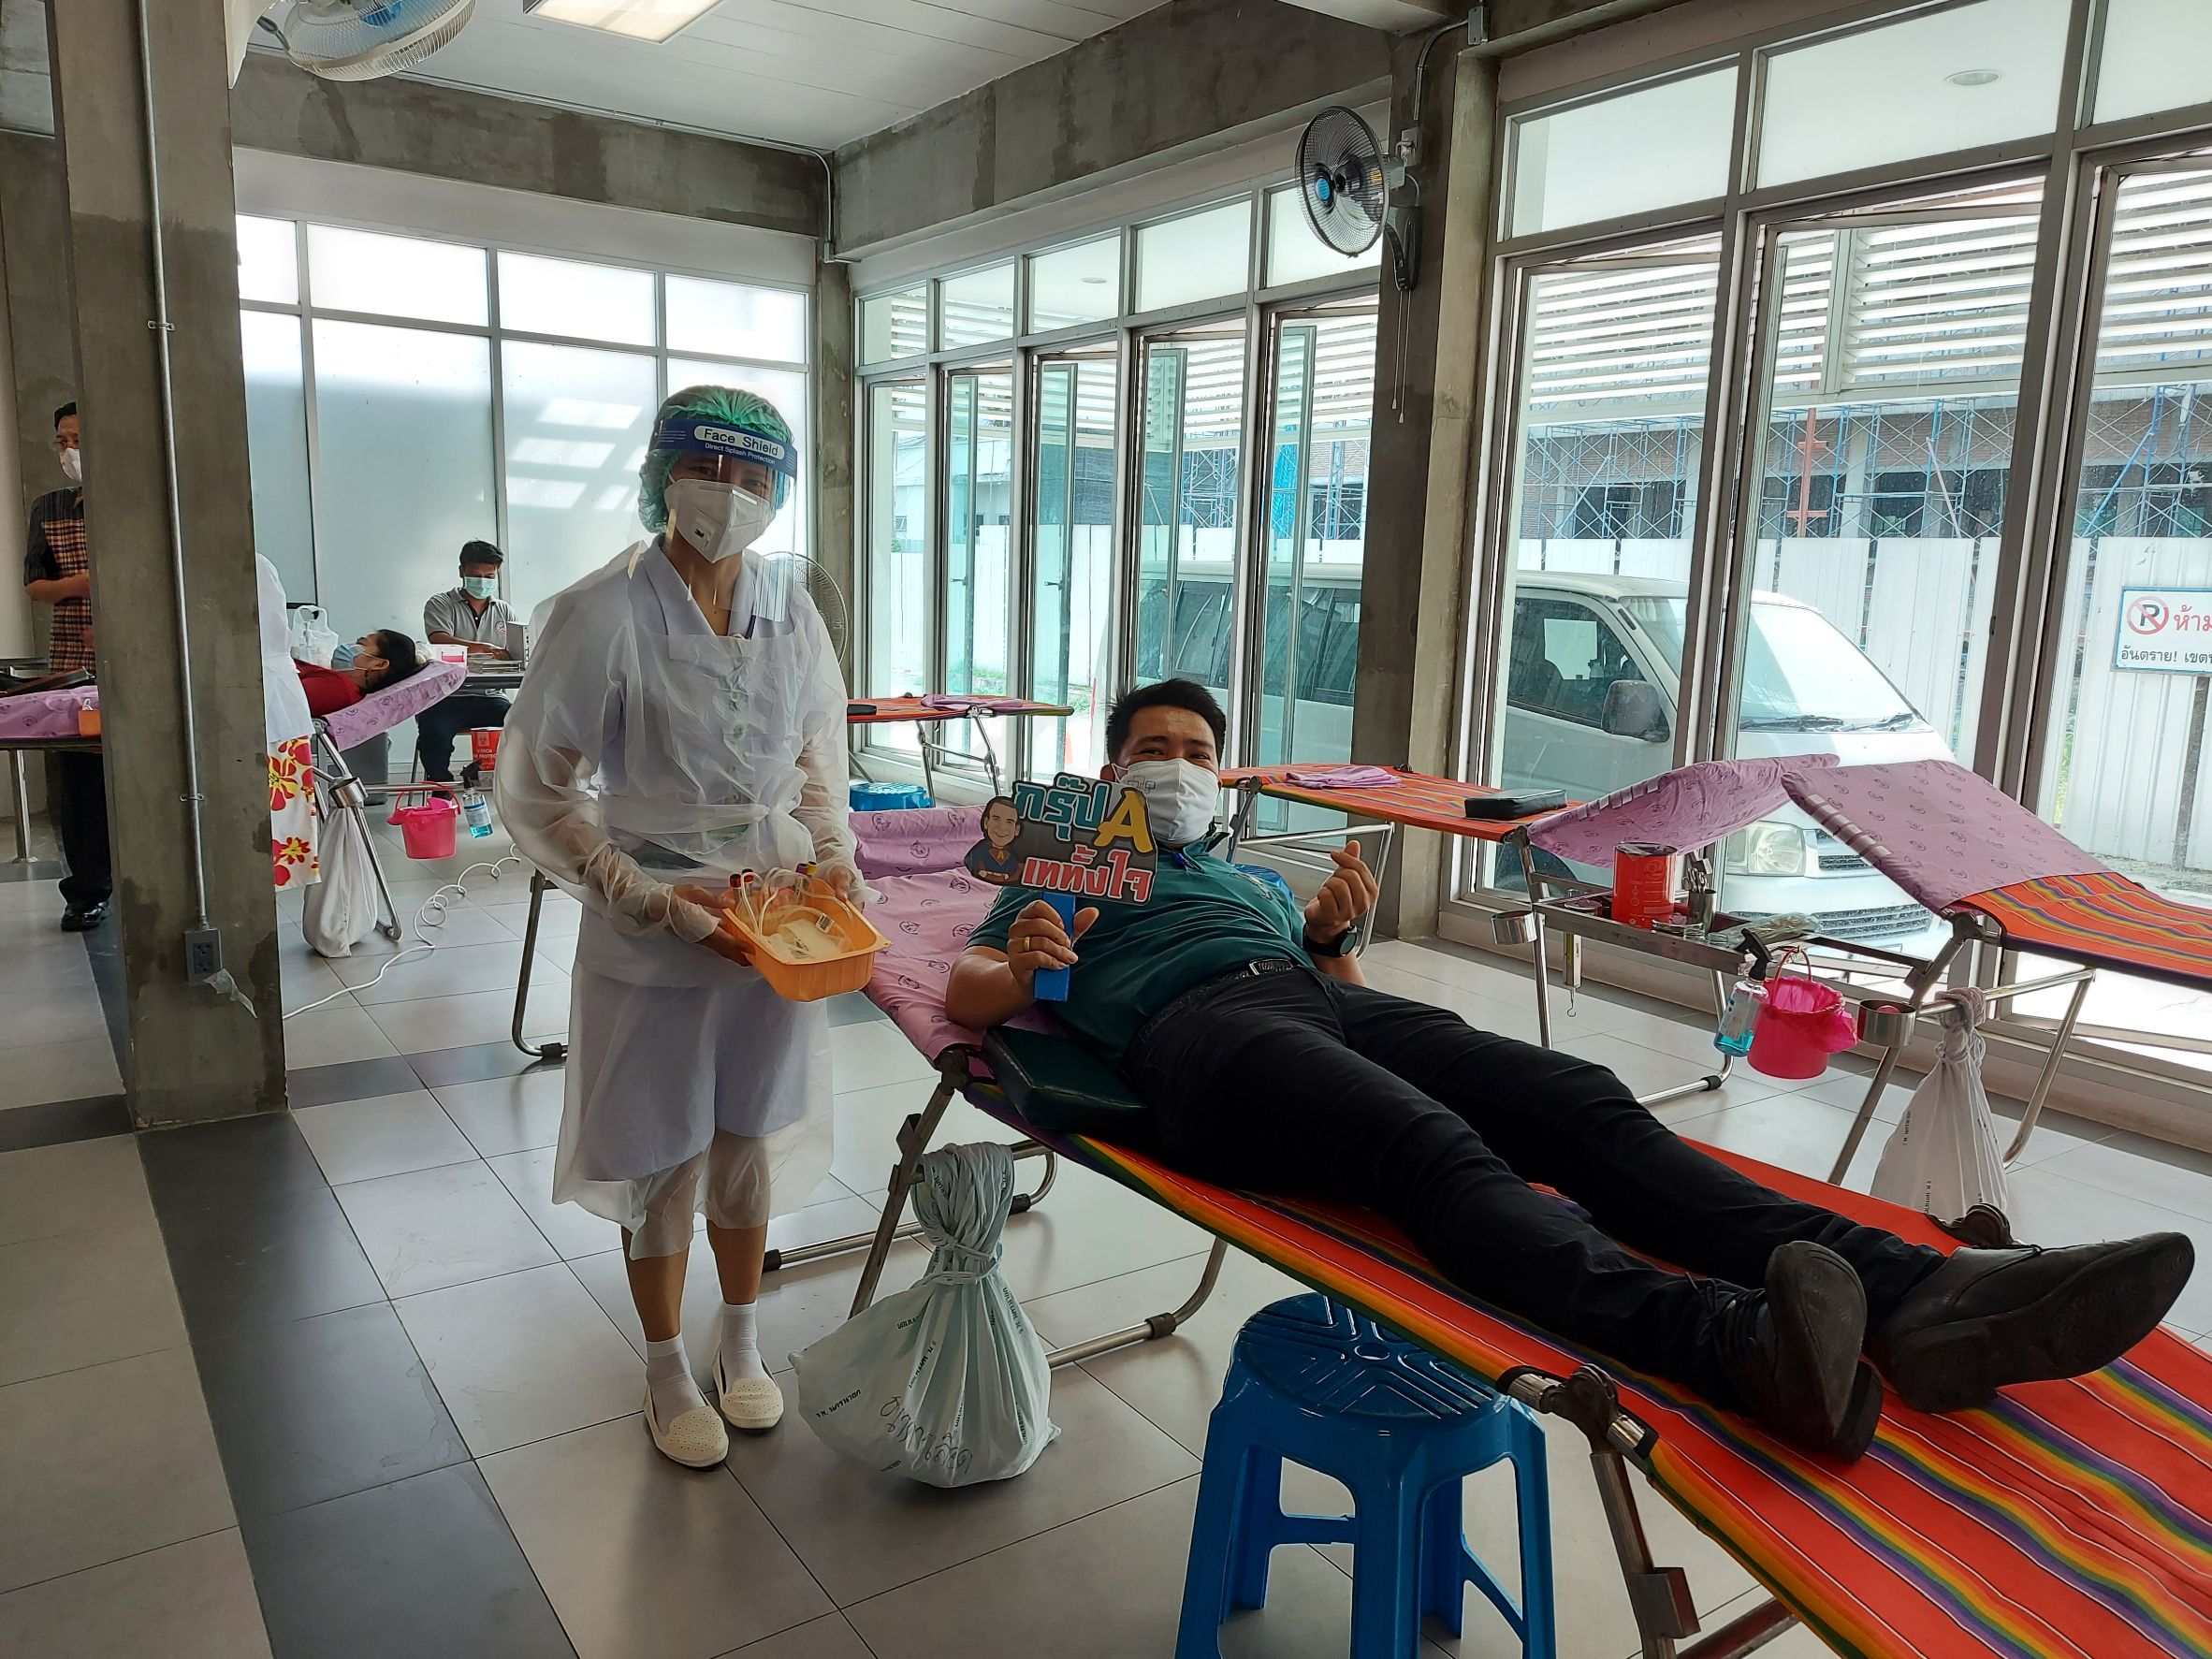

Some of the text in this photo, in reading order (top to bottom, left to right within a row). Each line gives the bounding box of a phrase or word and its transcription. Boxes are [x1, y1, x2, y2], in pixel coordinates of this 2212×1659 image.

[704, 428, 779, 457] Face Shield
[705, 443, 776, 465] Direct Splash Protection
[2121, 645, 2177, 662] อันตราย!
[1094, 790, 1154, 853] A
[1022, 844, 1154, 902] เททั้งใจ
